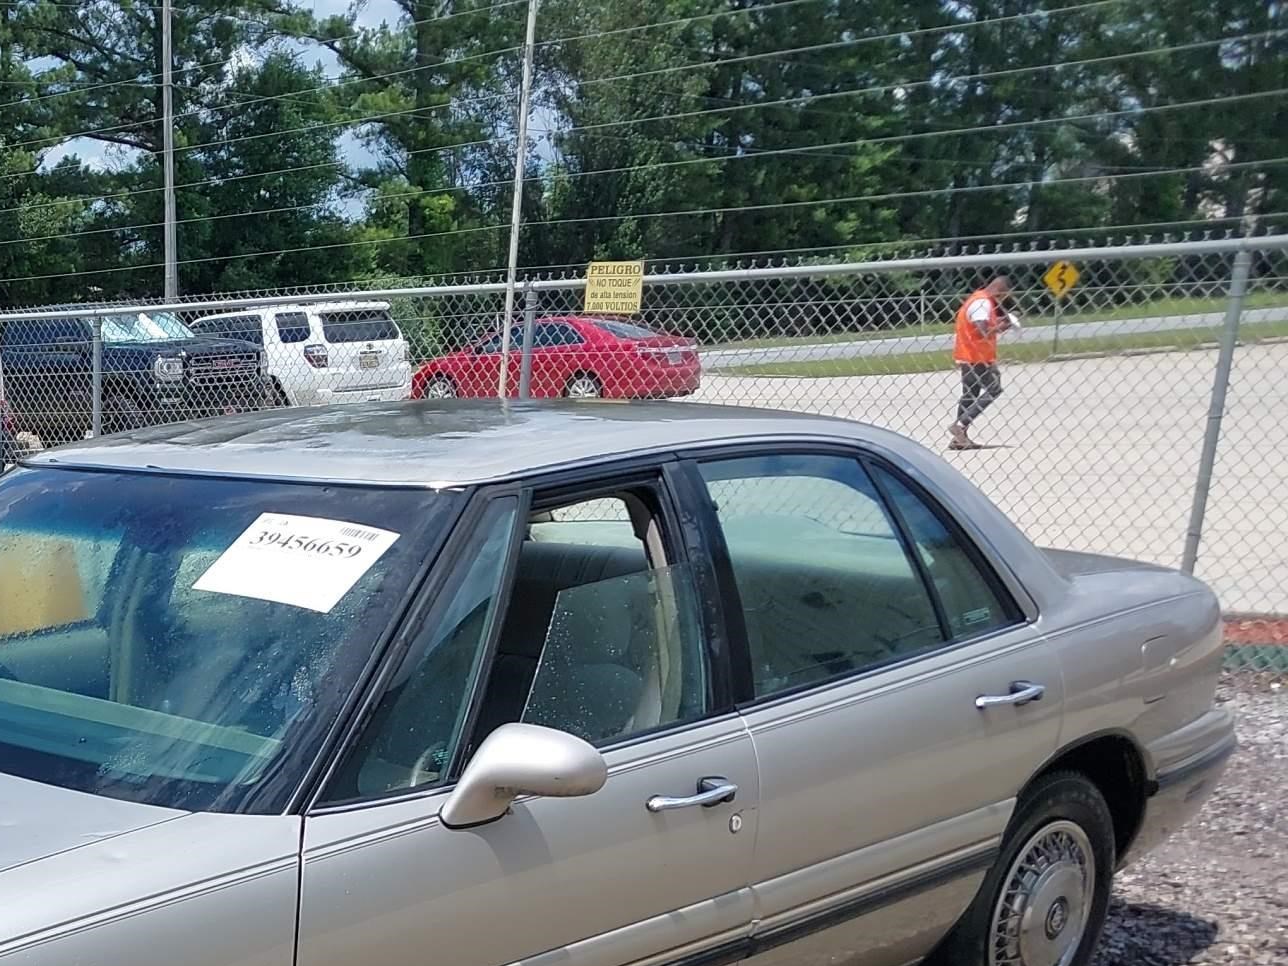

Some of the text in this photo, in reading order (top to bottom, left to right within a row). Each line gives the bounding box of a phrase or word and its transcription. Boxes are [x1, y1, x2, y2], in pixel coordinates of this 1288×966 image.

[590, 265, 641, 275] PELIGRO
[596, 278, 632, 287] NO TOQUE
[600, 291, 611, 299] alta
[604, 302, 638, 311] VOLTIOS
[249, 530, 363, 559] 39456659
